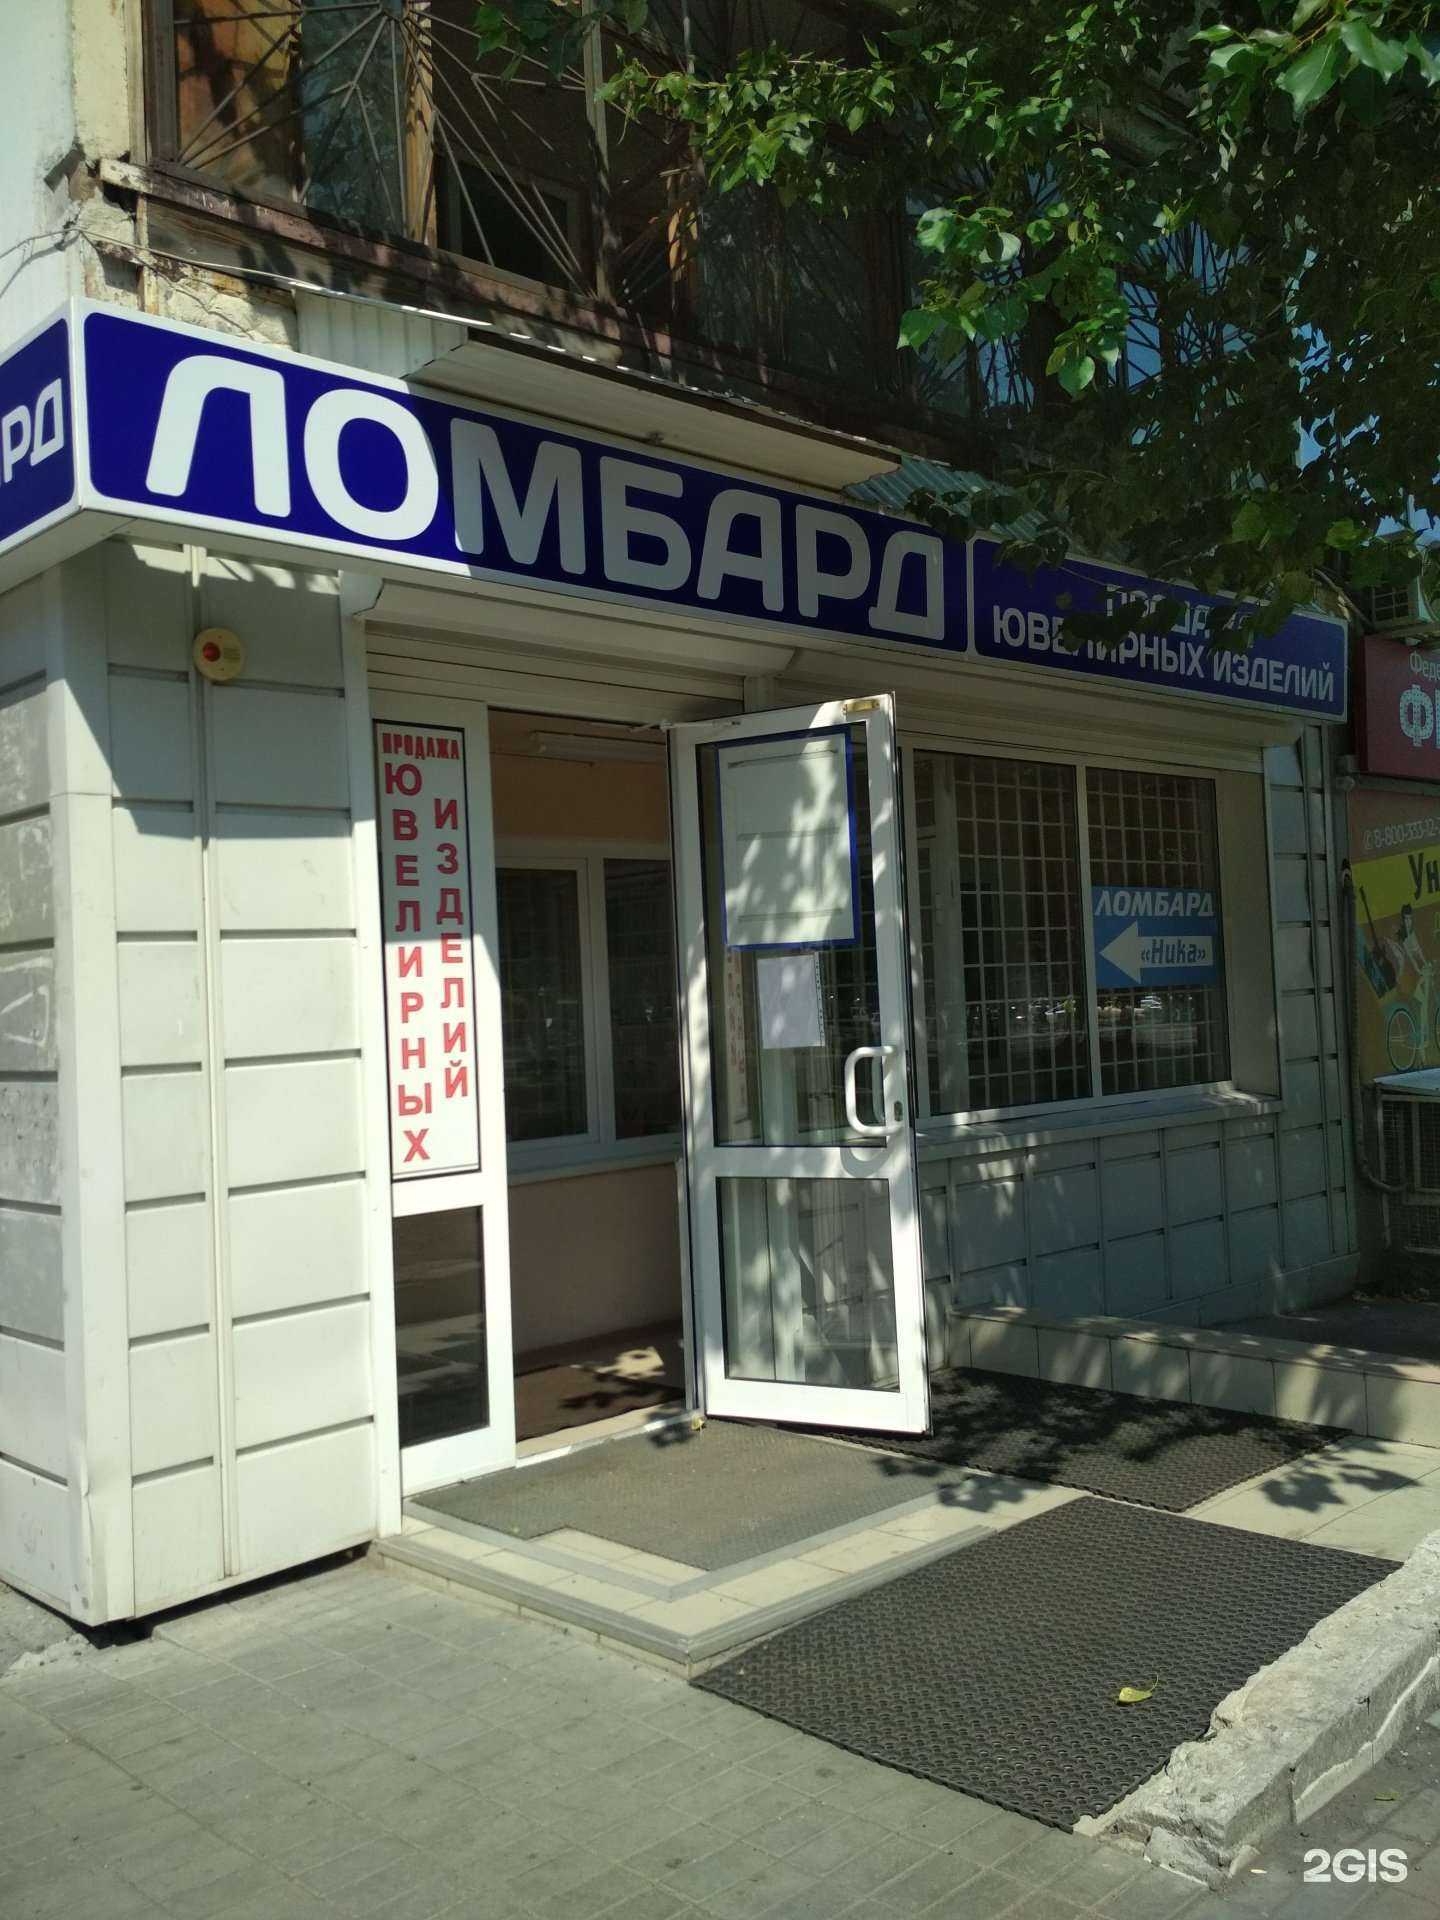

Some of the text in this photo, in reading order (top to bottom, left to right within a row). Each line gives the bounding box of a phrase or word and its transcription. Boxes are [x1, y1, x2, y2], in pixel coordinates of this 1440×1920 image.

[1, 378, 64, 484] РД
[145, 354, 945, 641] ЛОМБАРД
[1212, 653, 1334, 702] ИЗДЕЛИЙ
[382, 732, 460, 760] ПРОДАЖА
[434, 798, 469, 1098] ИЗДЕЛИЙ
[1094, 889, 1215, 917] ЛОМБАРД
[384, 762, 432, 1163] ЮВЕЛИРНЫХ
